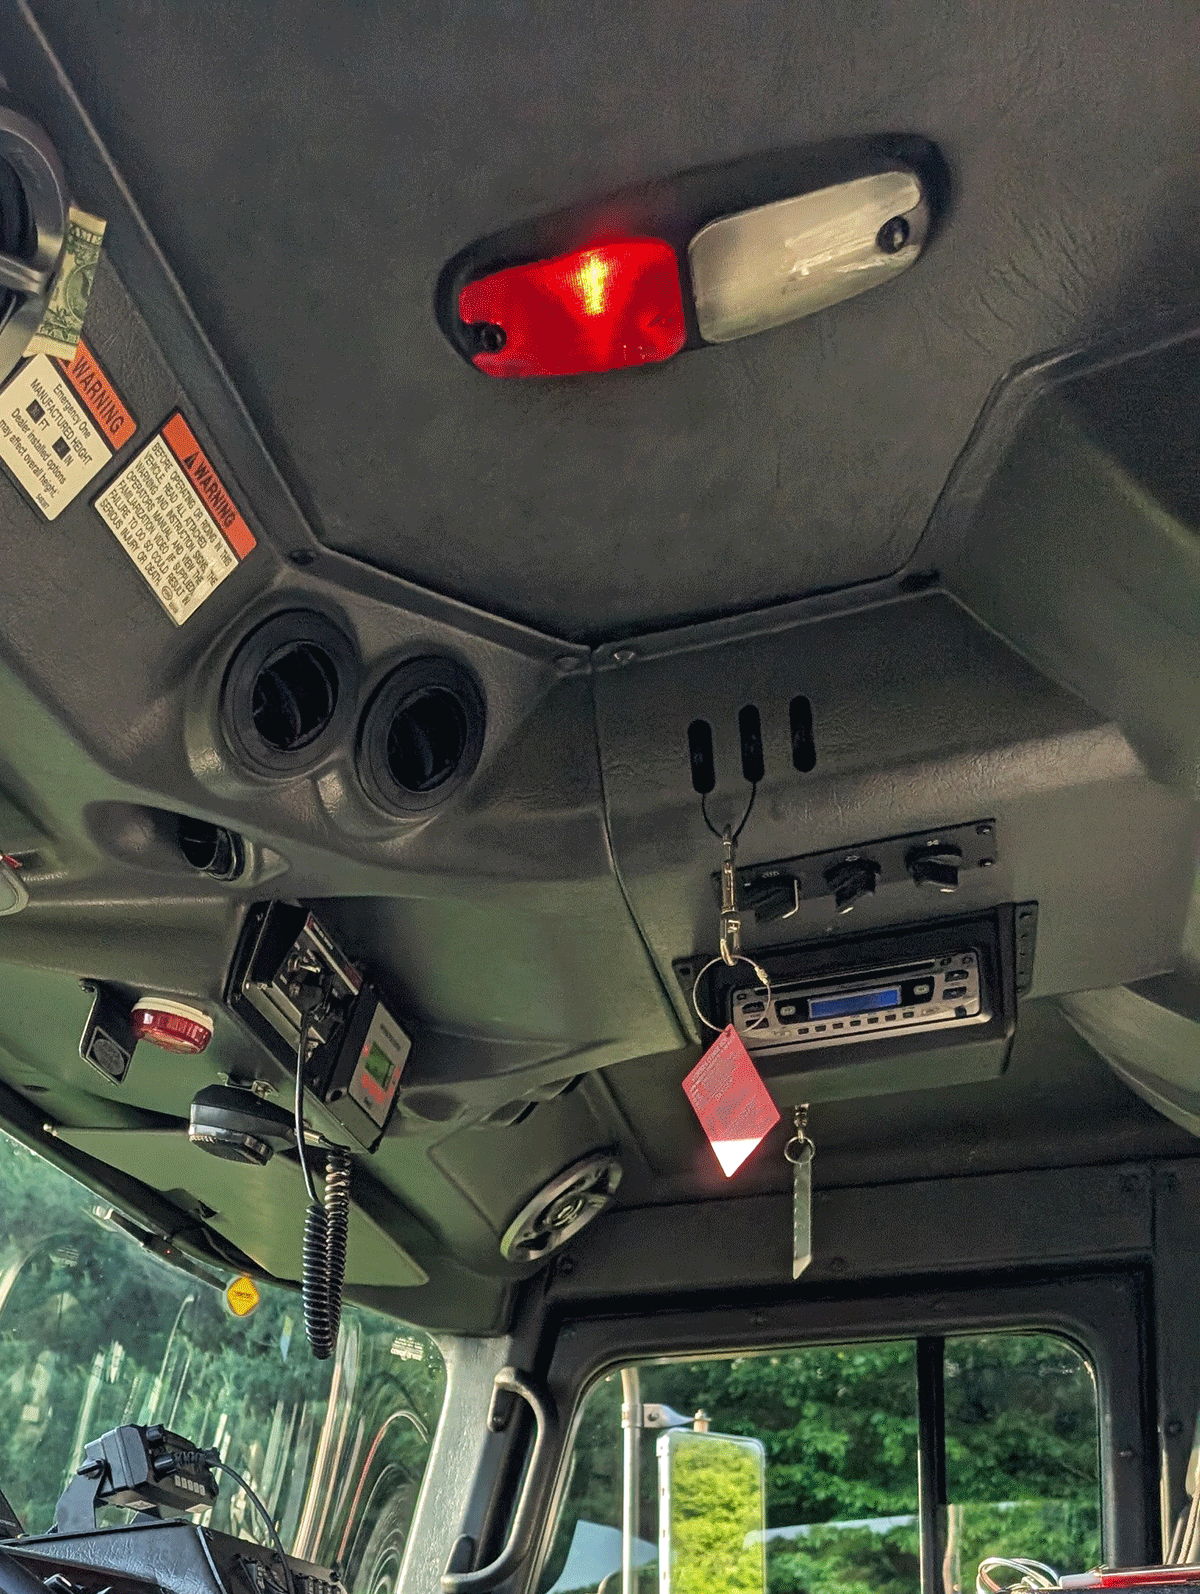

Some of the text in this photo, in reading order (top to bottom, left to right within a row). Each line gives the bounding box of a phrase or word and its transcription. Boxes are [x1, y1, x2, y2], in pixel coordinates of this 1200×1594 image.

[31, 378, 92, 465] MANUFACTURED HEIGHT
[52, 383, 92, 438] Emergency One
[73, 356, 125, 434] WARNING
[9, 432, 28, 455] affect
[23, 452, 43, 476] overall
[11, 408, 67, 485] Dealer installed options
[38, 418, 49, 432] FT
[63, 454, 73, 466] IN
[100, 498, 123, 528] SERIOUS
[120, 527, 139, 552] INJURY
[137, 551, 147, 563] OR
[117, 479, 156, 534] FAMILIARIZATION
[153, 533, 169, 554] VIDEO
[134, 461, 159, 494] WARNING
[156, 493, 169, 510] AND
[166, 509, 195, 551] INSTRUCTION
[206, 571, 218, 585] THE
[152, 442, 232, 566] BEFORE OPERATING OR RIDING IN THIS
[163, 482, 178, 503] READ
[175, 502, 187, 517] ALL
[184, 516, 207, 549] ATTACHED
[195, 462, 236, 529] WARNING
[108, 489, 130, 518] FAILURE
[128, 517, 138, 529] TO
[135, 528, 146, 540] DO
[143, 540, 153, 552] SO
[151, 551, 169, 574] COULD
[166, 573, 184, 597] RESULT
[182, 596, 190, 605] IN
[171, 539, 184, 555] AND
[181, 554, 195, 571] VIEW
[192, 571, 203, 584] THE
